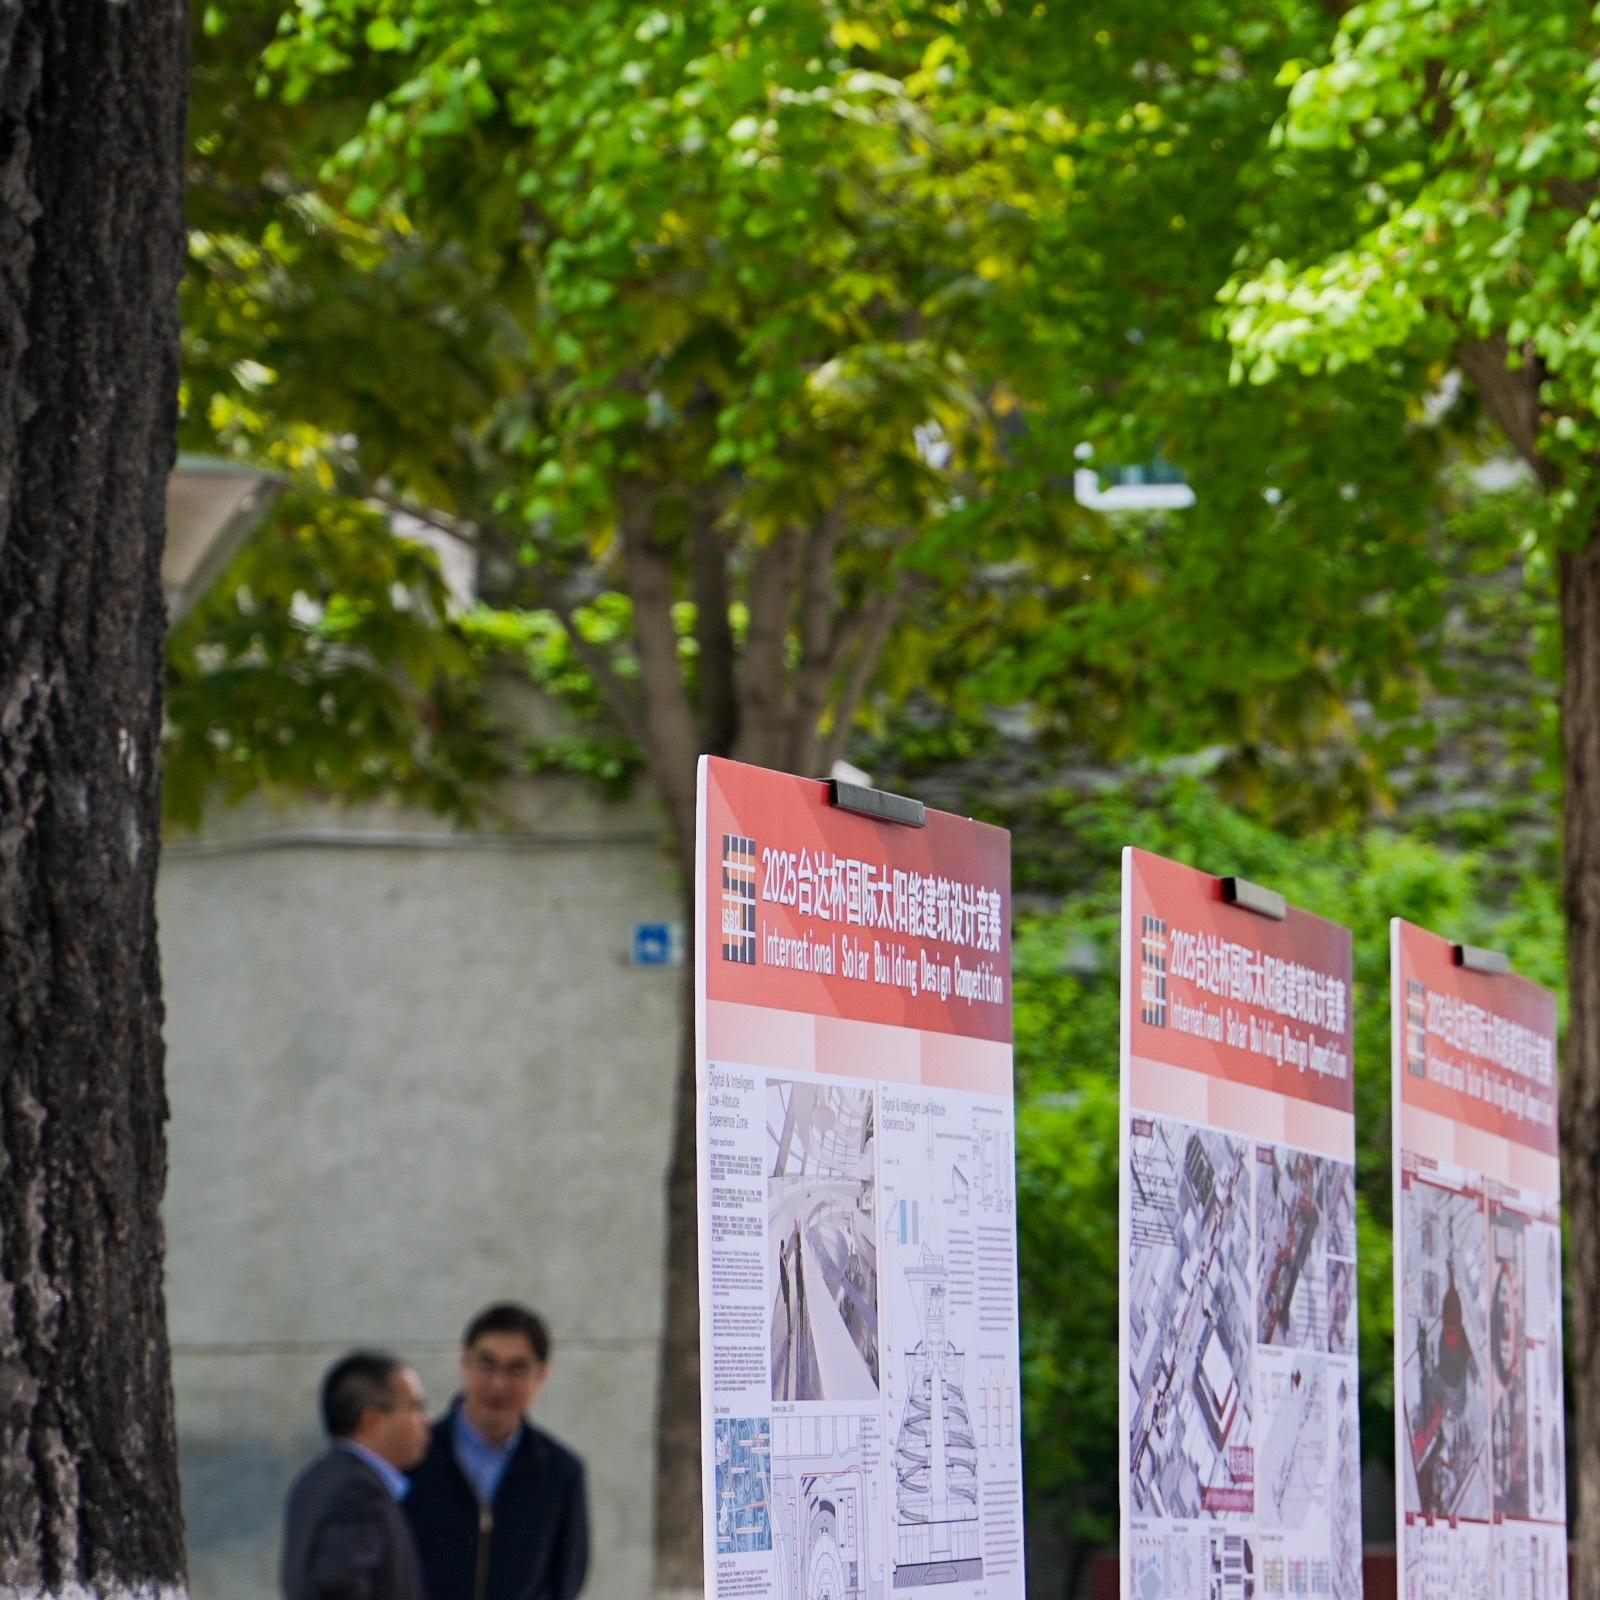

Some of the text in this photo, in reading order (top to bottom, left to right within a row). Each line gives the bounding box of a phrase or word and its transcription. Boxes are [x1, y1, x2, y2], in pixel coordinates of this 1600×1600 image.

[762, 847, 1002, 953] 2025台达杯国际太阳能建筑设计竞赛
[762, 920, 1004, 1006] International Solar Building Design Competition
